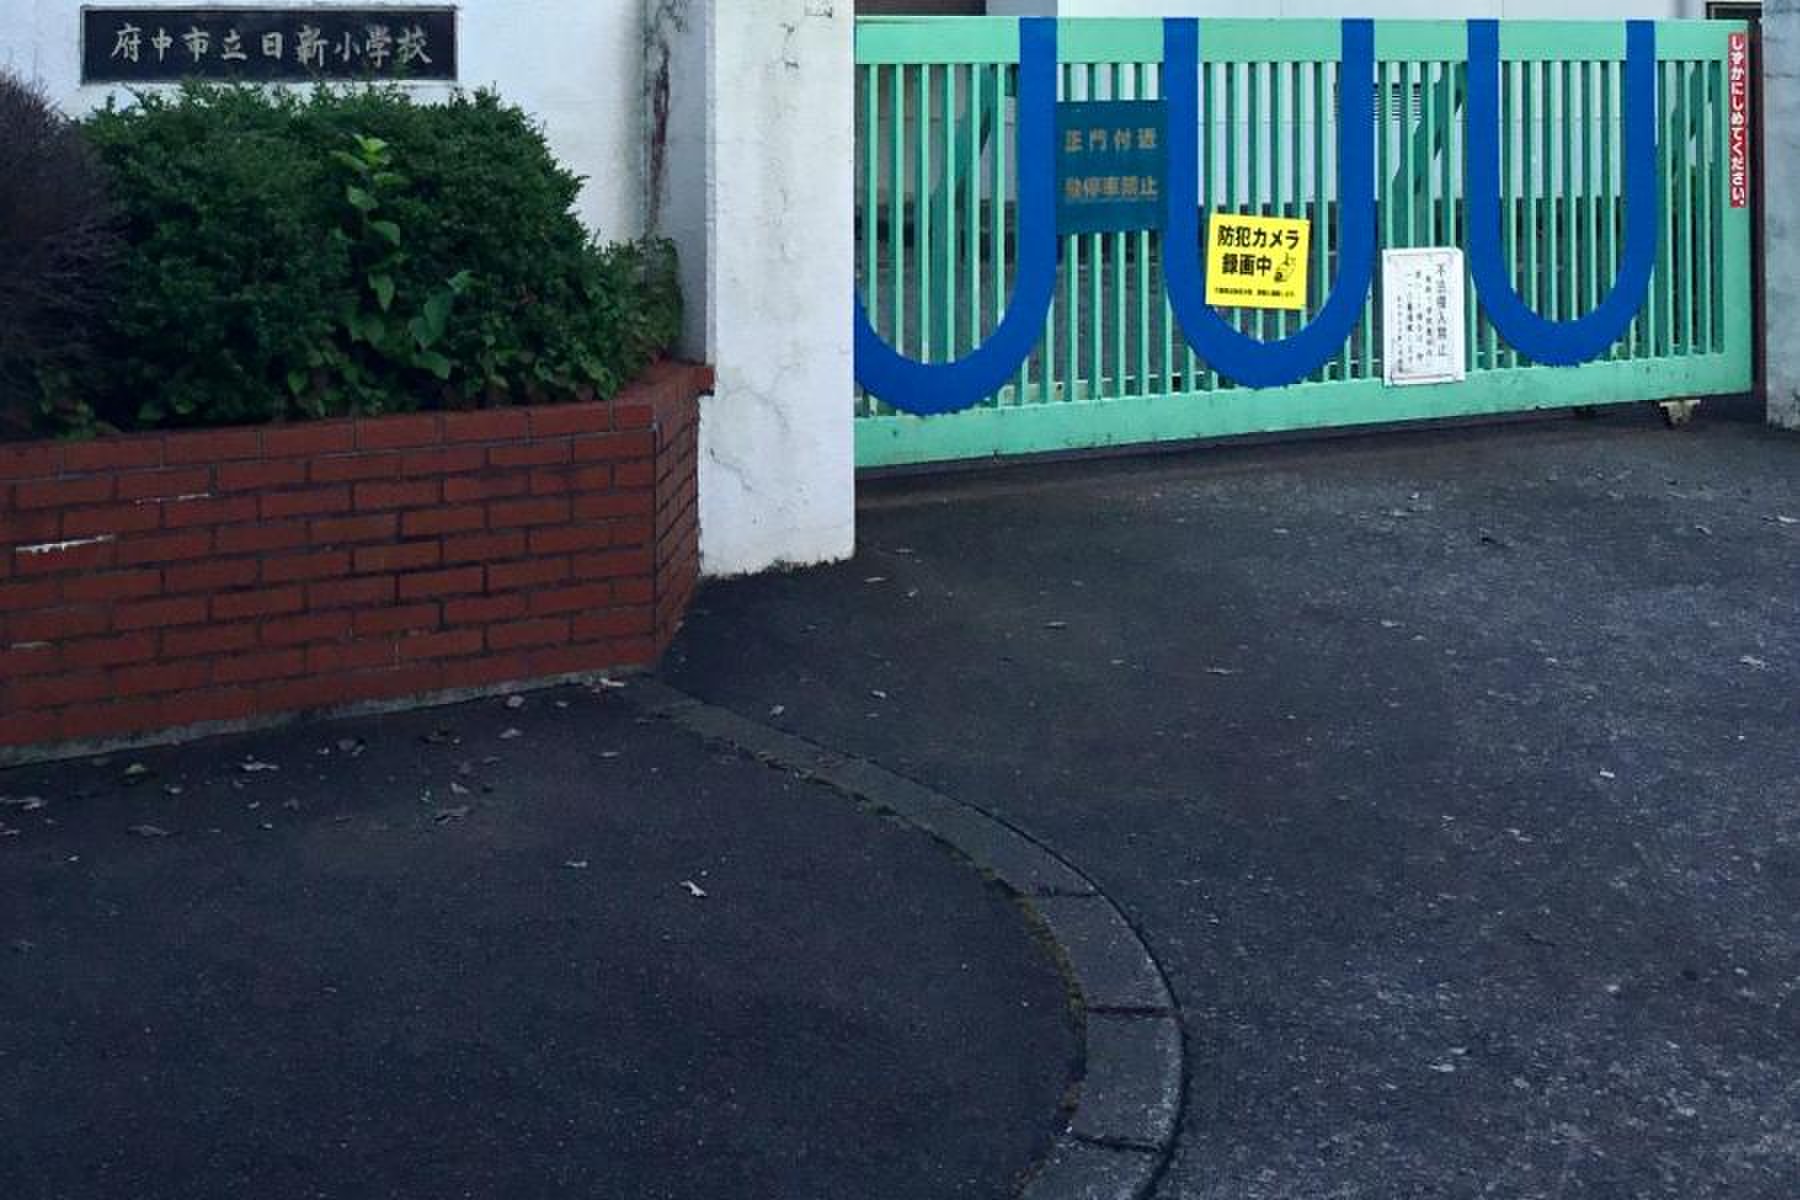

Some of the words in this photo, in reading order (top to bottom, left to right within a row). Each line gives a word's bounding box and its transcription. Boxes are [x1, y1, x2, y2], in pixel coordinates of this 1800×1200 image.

[111, 22, 432, 67] 府中市立日新小学校
[1217, 225, 1299, 250] 防犯カメラ
[1222, 253, 1271, 277] 録画中
